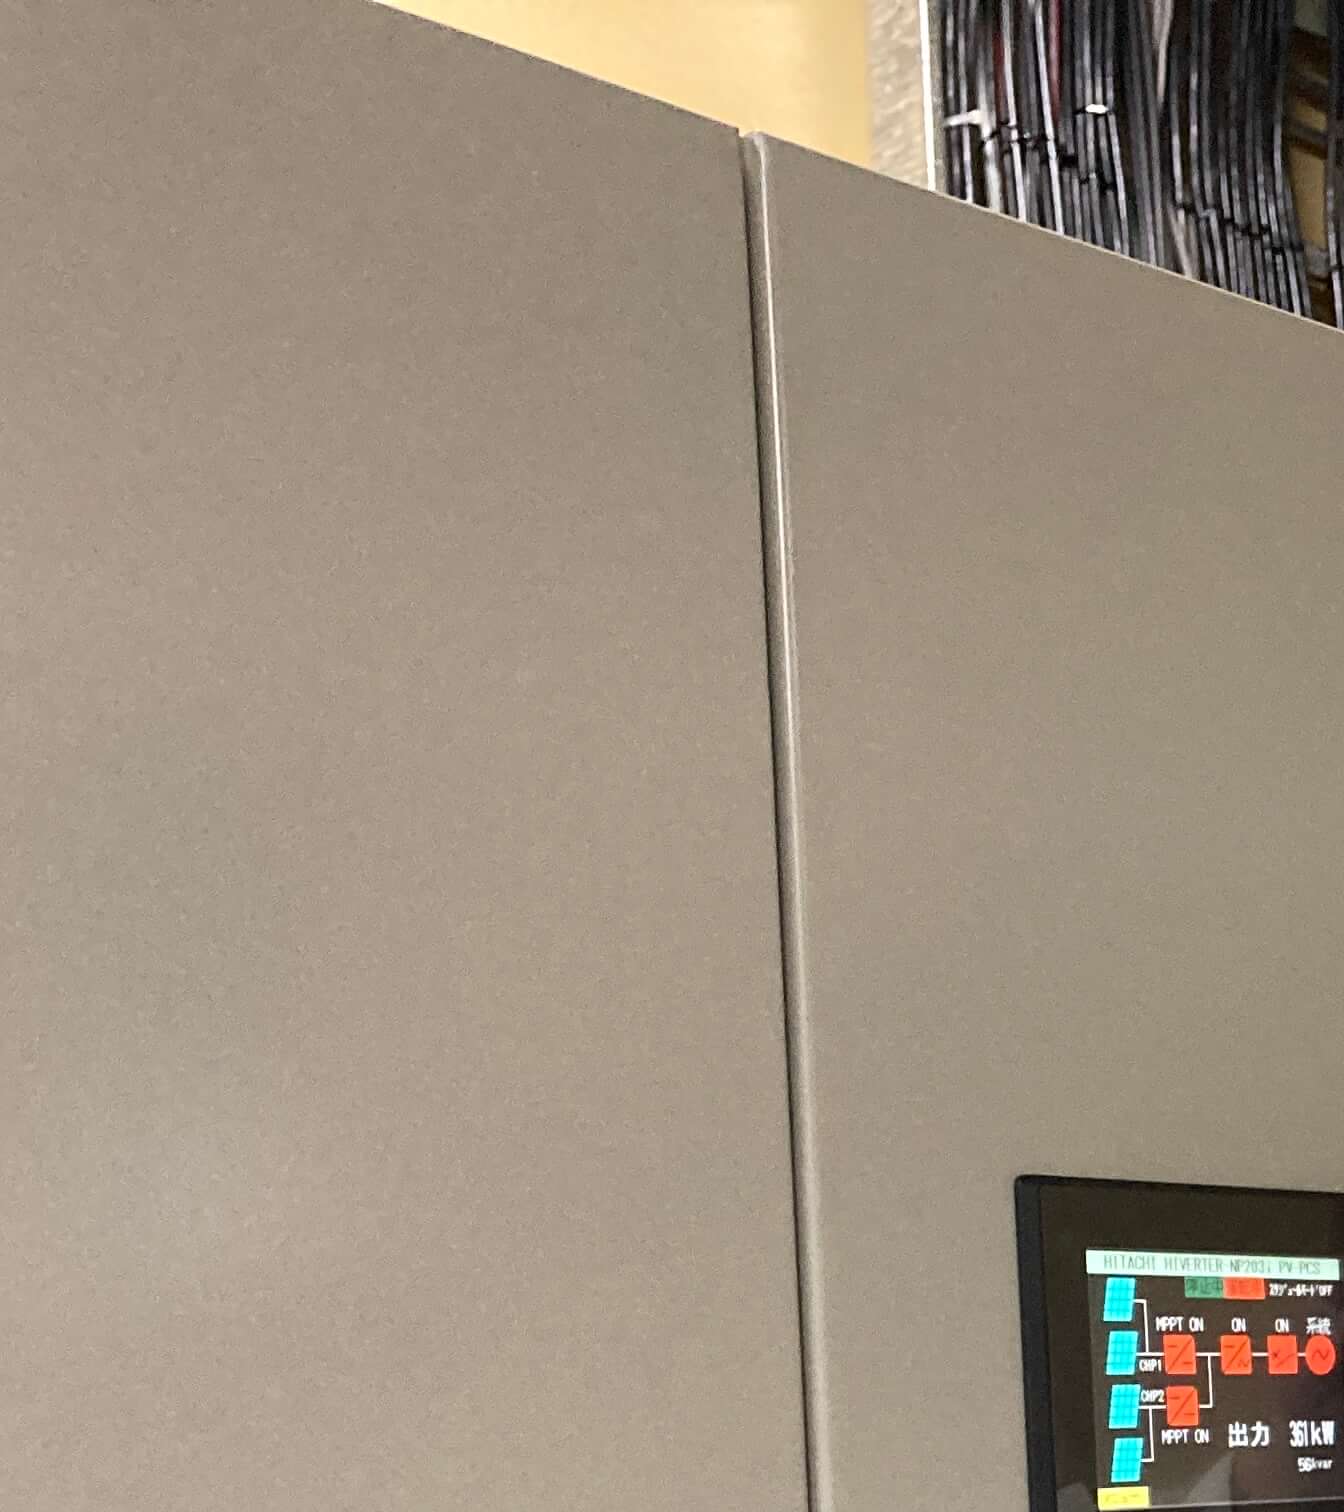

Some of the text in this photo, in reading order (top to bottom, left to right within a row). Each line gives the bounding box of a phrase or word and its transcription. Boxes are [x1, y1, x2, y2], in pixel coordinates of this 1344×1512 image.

[1103, 1254, 1156, 1271] HITACHI
[1156, 1316, 1204, 1332] MPPT ON
[1231, 1317, 1246, 1332] ON
[1275, 1318, 1290, 1332] ON
[1161, 1429, 1210, 1445] MPPT ON
[1228, 1421, 1270, 1448] 出力
